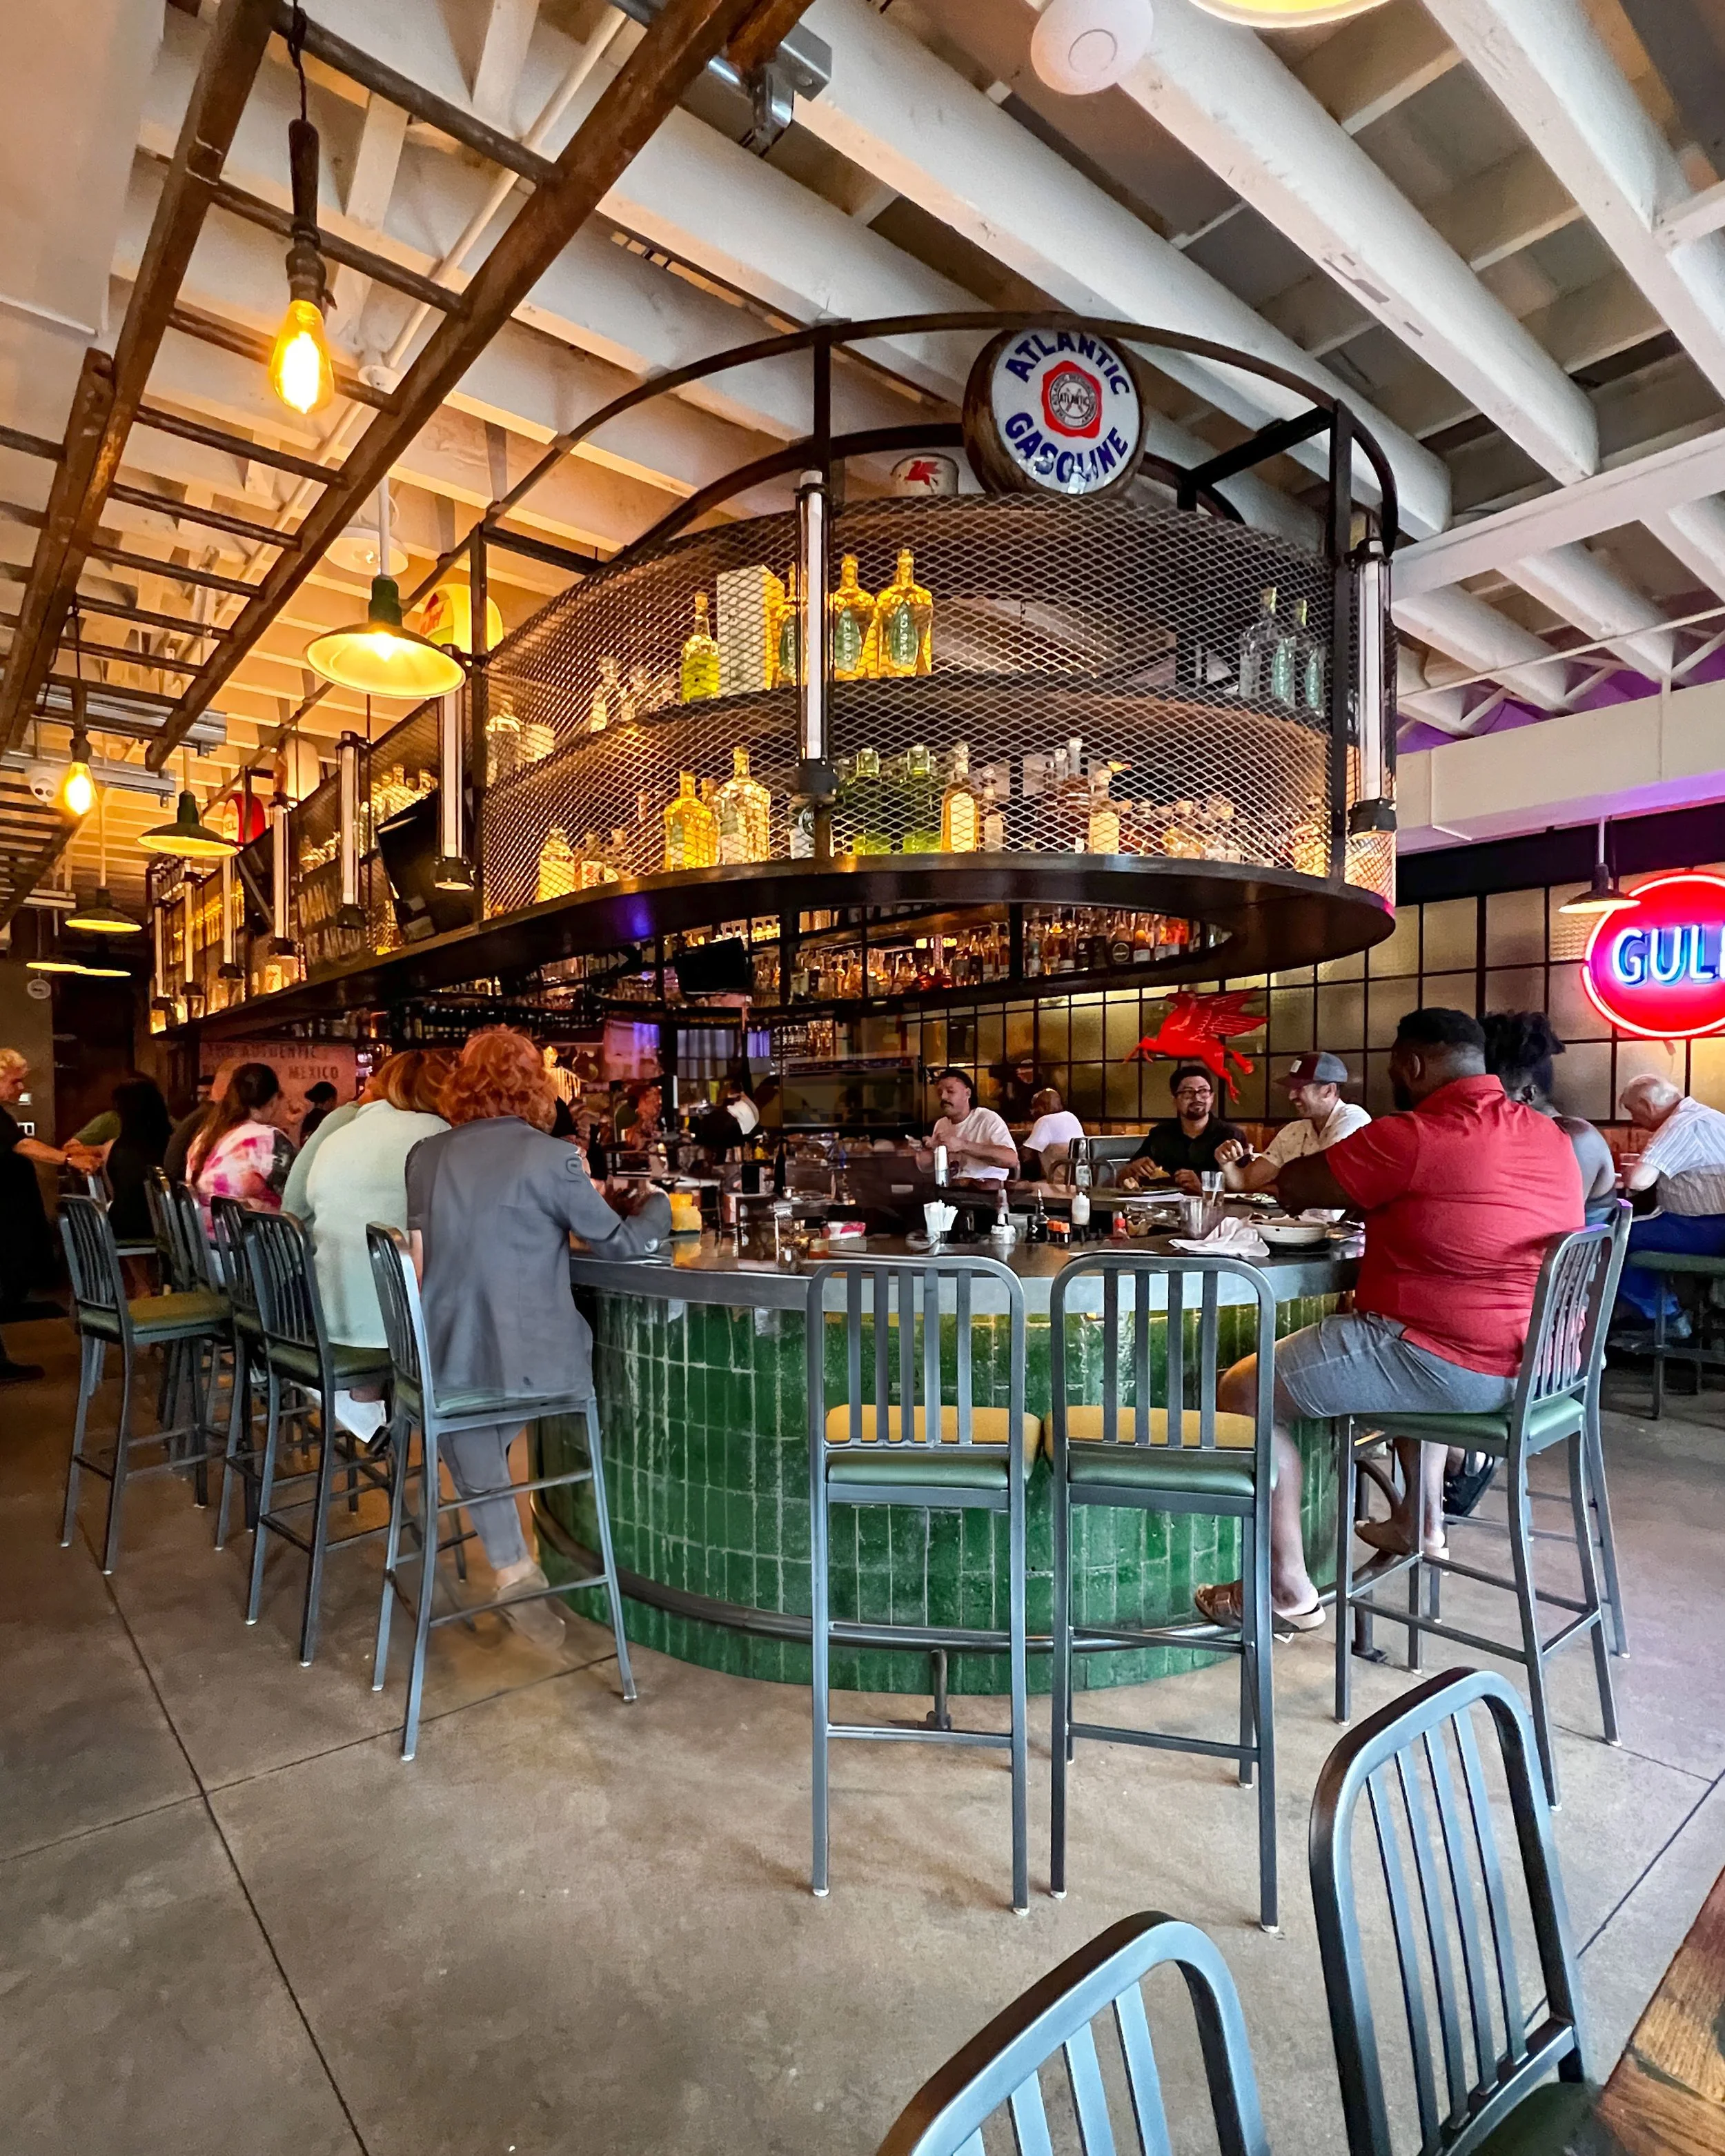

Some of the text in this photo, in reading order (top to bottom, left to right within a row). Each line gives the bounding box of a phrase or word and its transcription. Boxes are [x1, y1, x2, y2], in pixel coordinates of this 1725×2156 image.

[1005, 332, 1130, 395] ATLANTIC
[1005, 412, 1128, 483] GASOLINE
[288, 1066, 338, 1079] MEXICO
